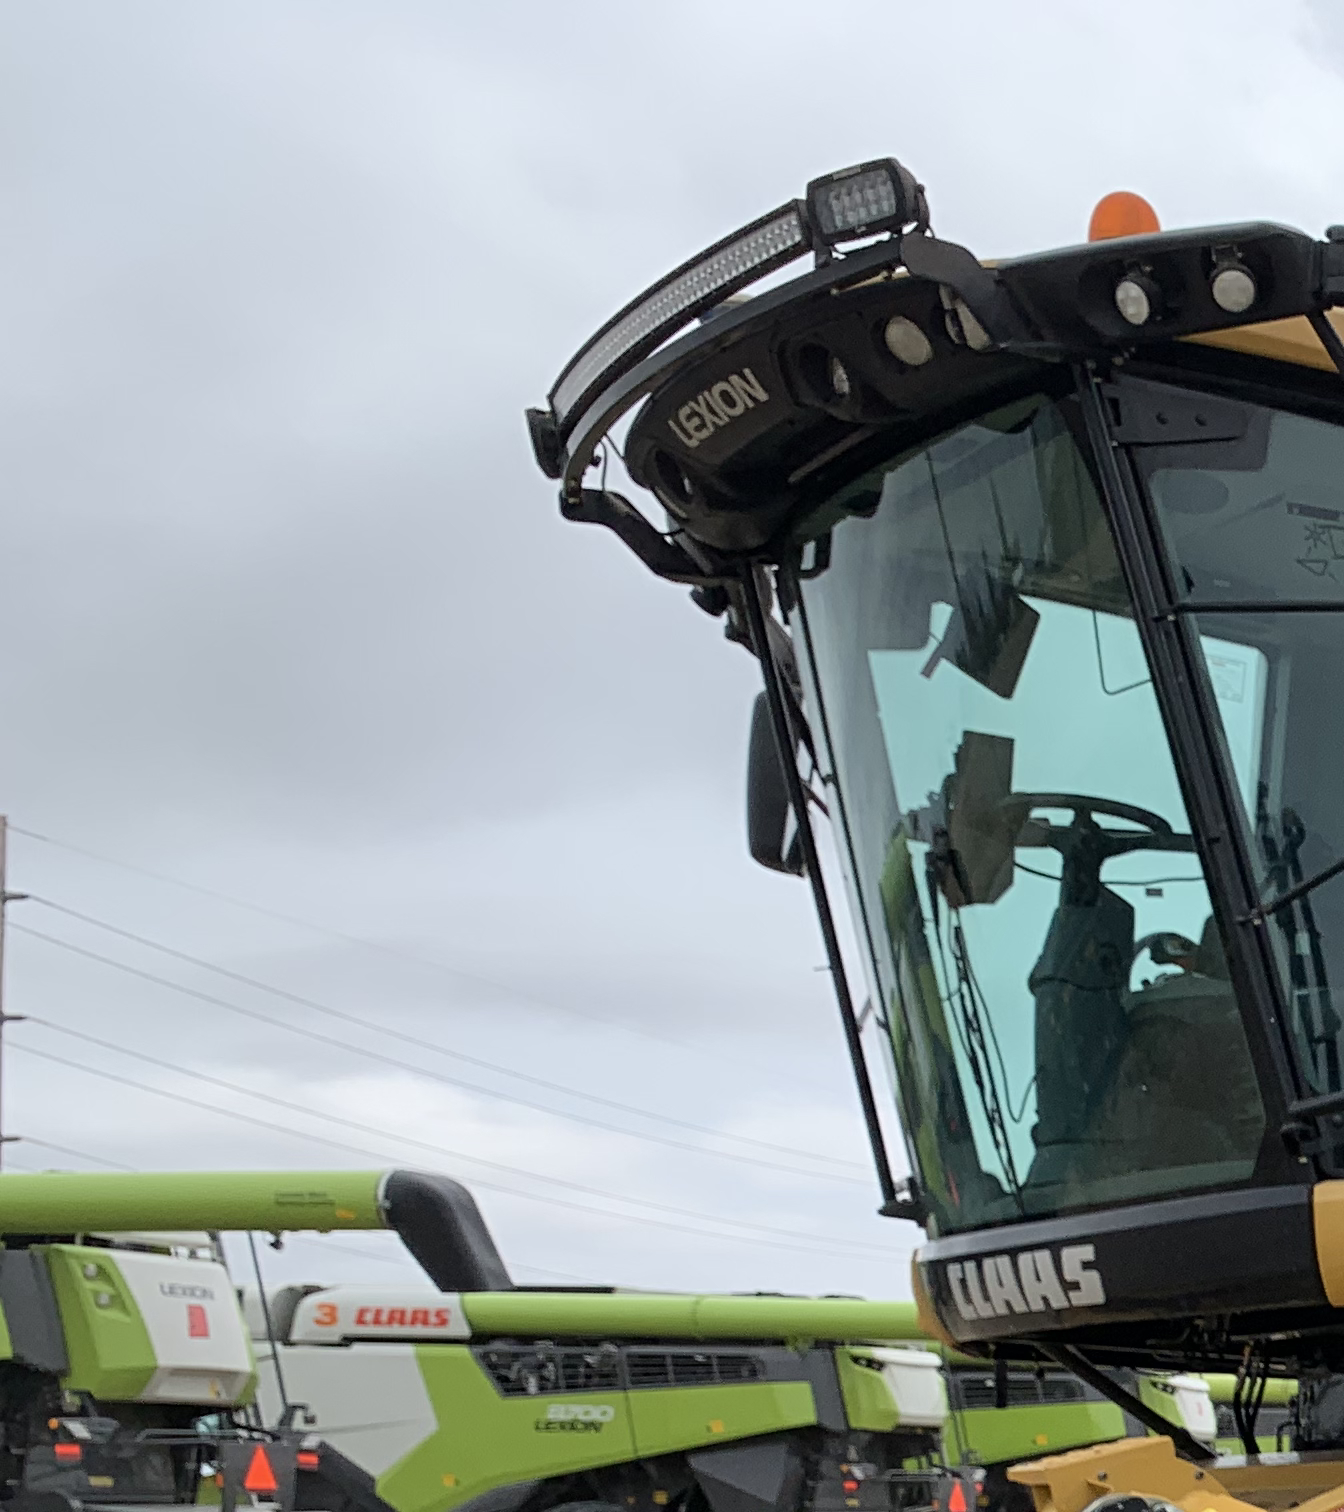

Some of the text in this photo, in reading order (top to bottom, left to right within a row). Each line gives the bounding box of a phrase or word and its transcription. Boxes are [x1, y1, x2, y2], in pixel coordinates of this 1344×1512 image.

[667, 367, 769, 448] LEXION
[313, 1302, 451, 1328] 3 CLAAS
[947, 1243, 1107, 1322] CLAAS
